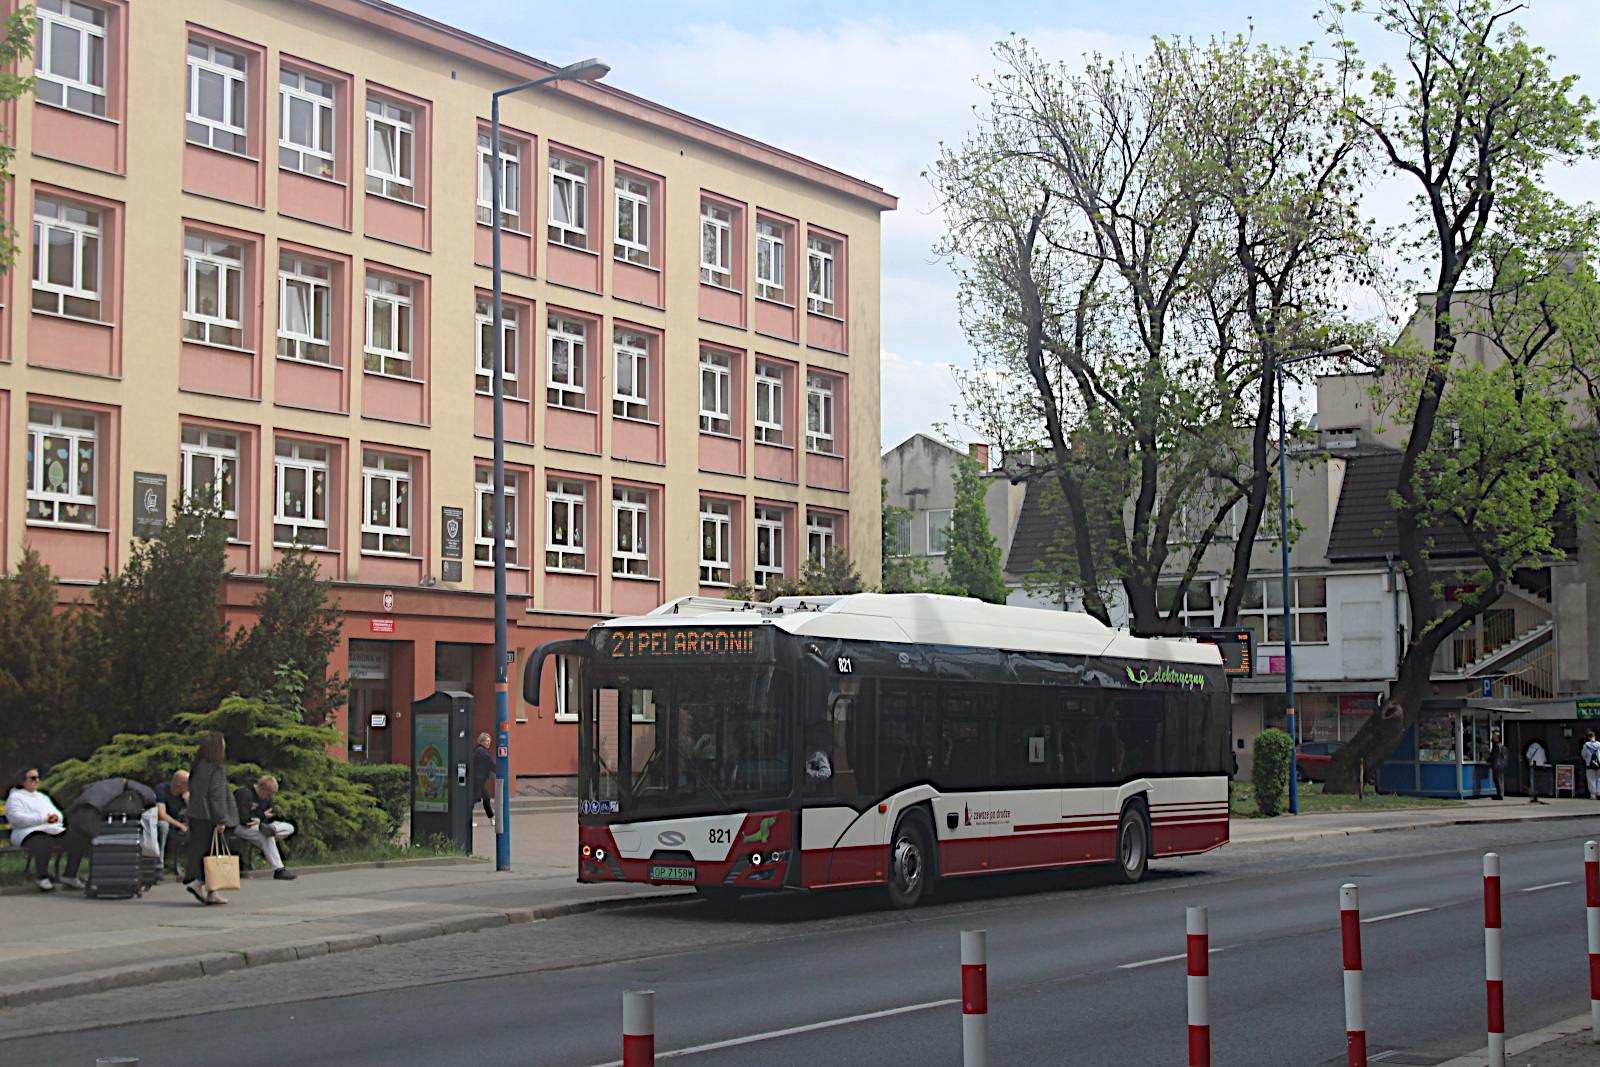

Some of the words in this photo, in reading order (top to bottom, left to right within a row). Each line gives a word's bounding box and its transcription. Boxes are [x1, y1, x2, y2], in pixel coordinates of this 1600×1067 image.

[612, 631, 634, 657] 21
[638, 631, 753, 655] PELARGONII
[838, 657, 852, 673] 821
[1153, 665, 1204, 691] elektryczny
[973, 811, 989, 820] zawsze
[990, 811, 996, 821] po
[996, 809, 1010, 819] drodze
[708, 828, 731, 844] 821
[654, 867, 666, 877] OP
[668, 868, 694, 879] 7158W
